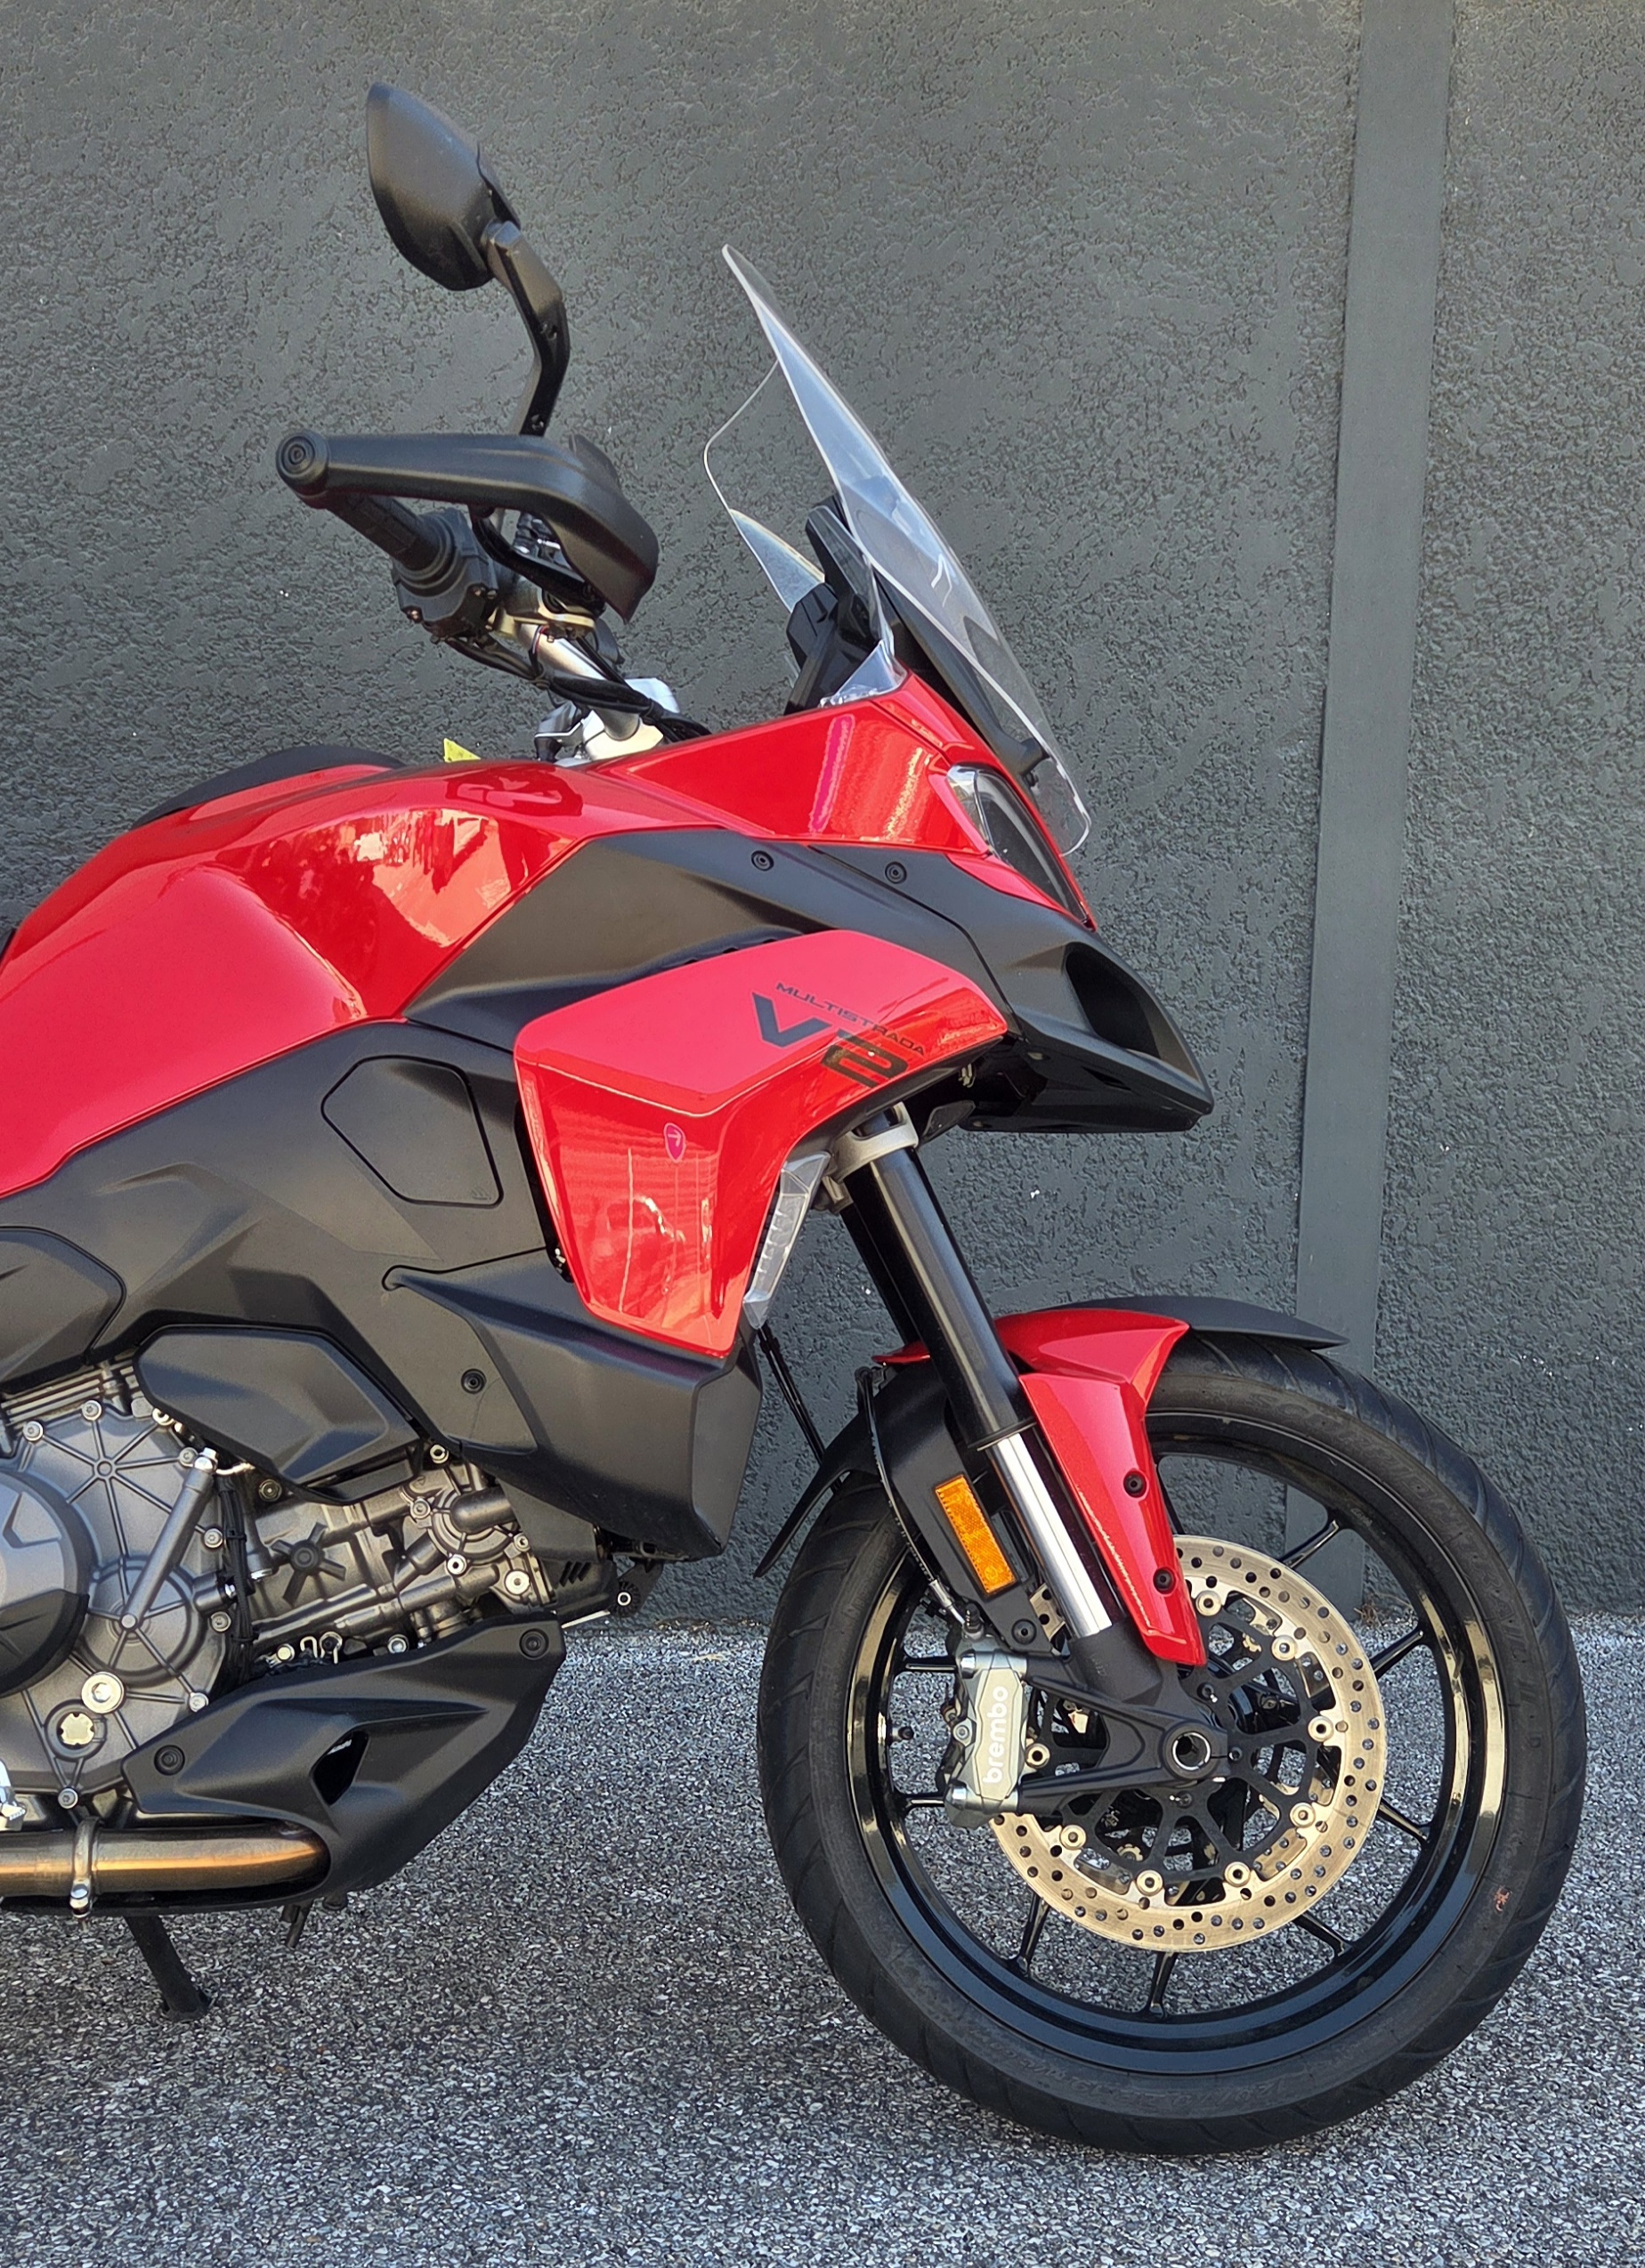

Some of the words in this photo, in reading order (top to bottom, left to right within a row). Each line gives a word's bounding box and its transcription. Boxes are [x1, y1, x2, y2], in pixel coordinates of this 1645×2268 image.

[752, 992, 909, 1089] V2
[776, 983, 926, 1057] MULTISTRADA
[983, 1686, 1009, 1784] brembo
